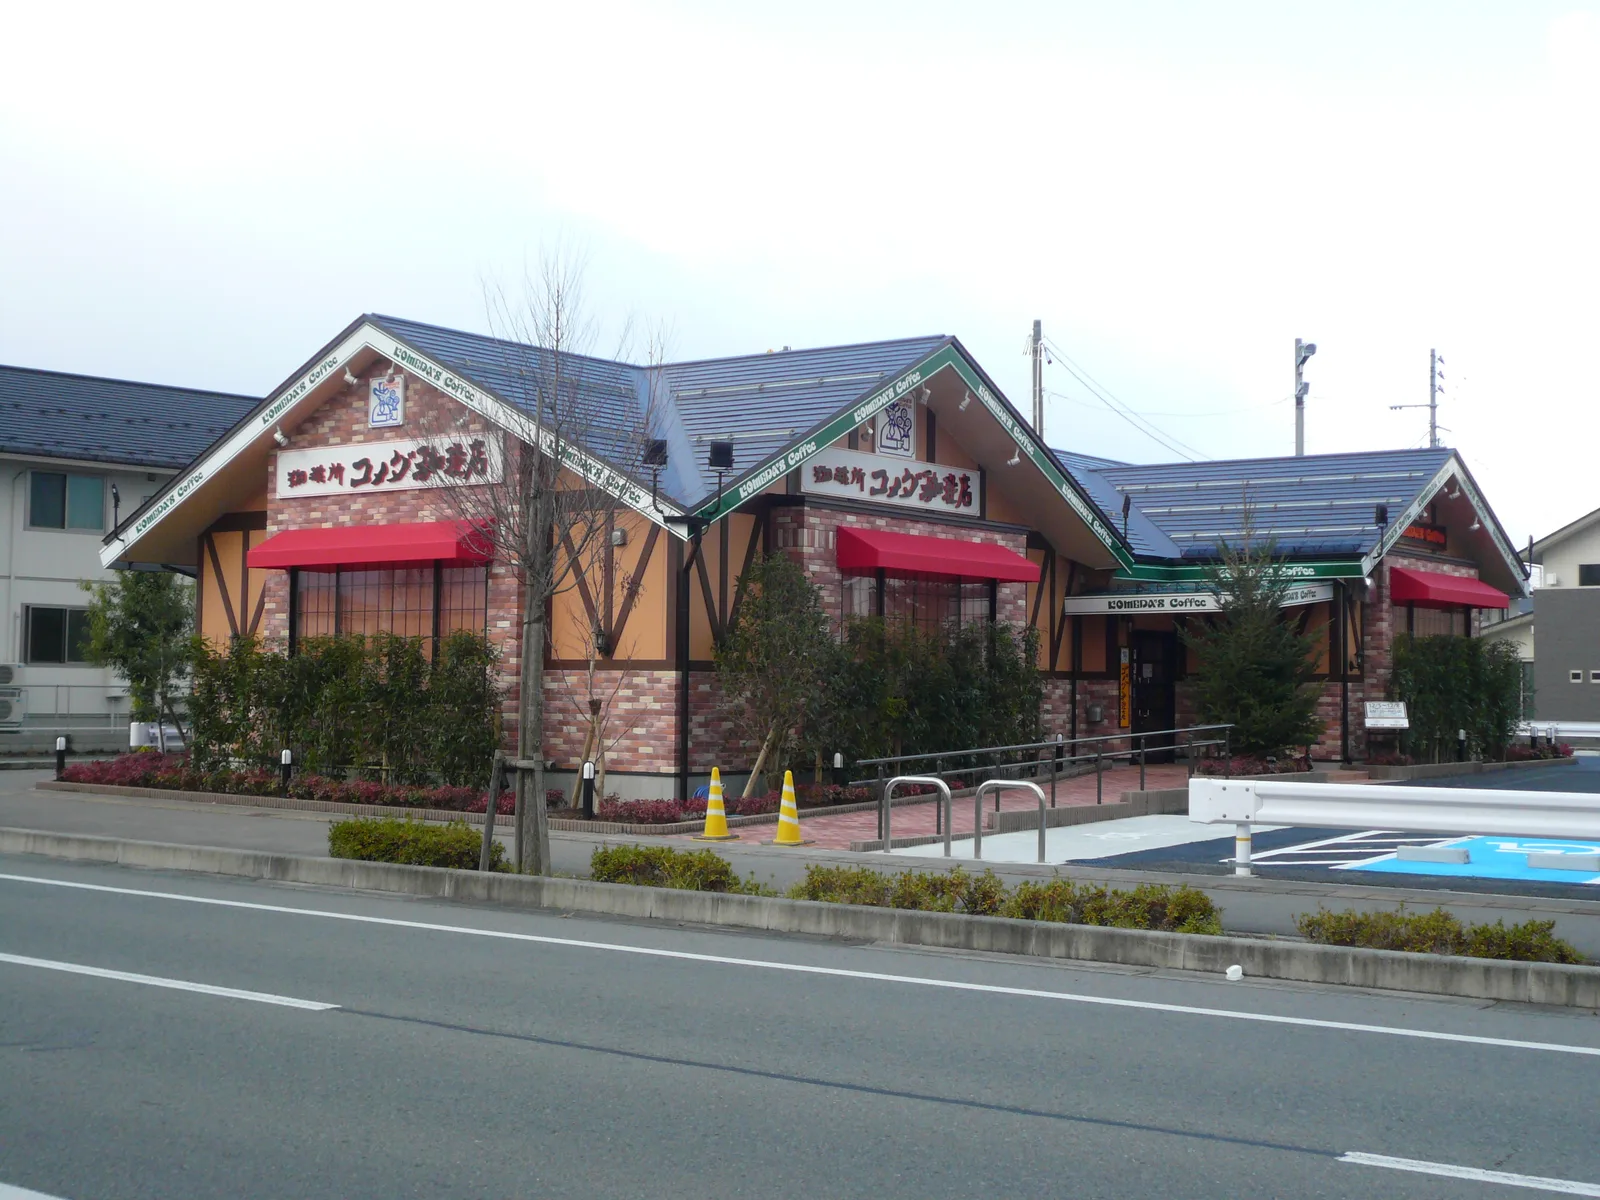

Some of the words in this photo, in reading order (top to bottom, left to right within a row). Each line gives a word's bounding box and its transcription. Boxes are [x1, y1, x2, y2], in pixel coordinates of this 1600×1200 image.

[262, 381, 306, 425] KOMEDA'S
[308, 356, 338, 385] Coffee
[854, 387, 895, 423] KOMEDA'S
[896, 371, 921, 393] Coffee
[739, 458, 786, 499] KOMEDA'S
[787, 440, 817, 466] Coffee
[135, 495, 175, 535] KOMEDA'S
[177, 472, 204, 498] Coffee
[1108, 599, 1165, 610] KOMEDA'S
[1169, 598, 1207, 608] Coffee
